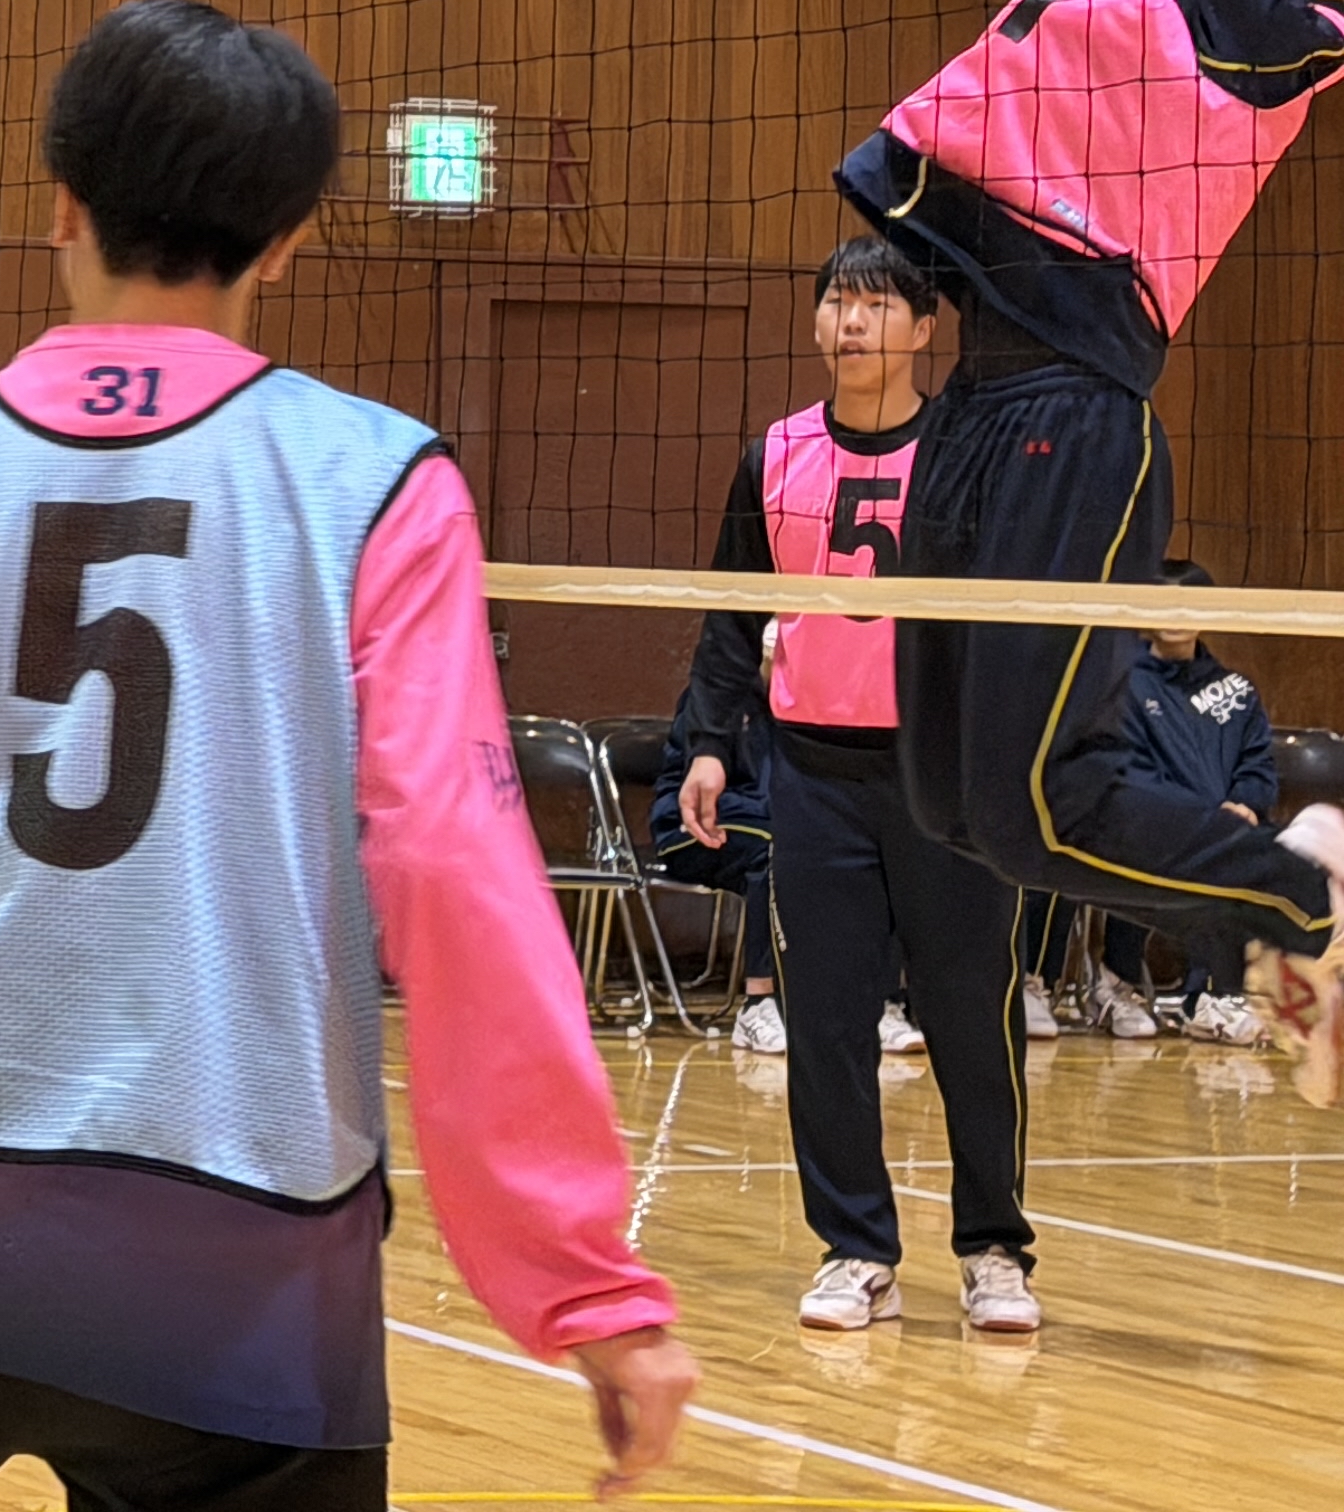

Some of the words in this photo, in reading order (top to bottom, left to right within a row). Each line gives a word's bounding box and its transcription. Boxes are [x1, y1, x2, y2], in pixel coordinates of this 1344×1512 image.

[77, 365, 161, 418] 31
[829, 476, 903, 623] 5
[6, 496, 194, 870] 5
